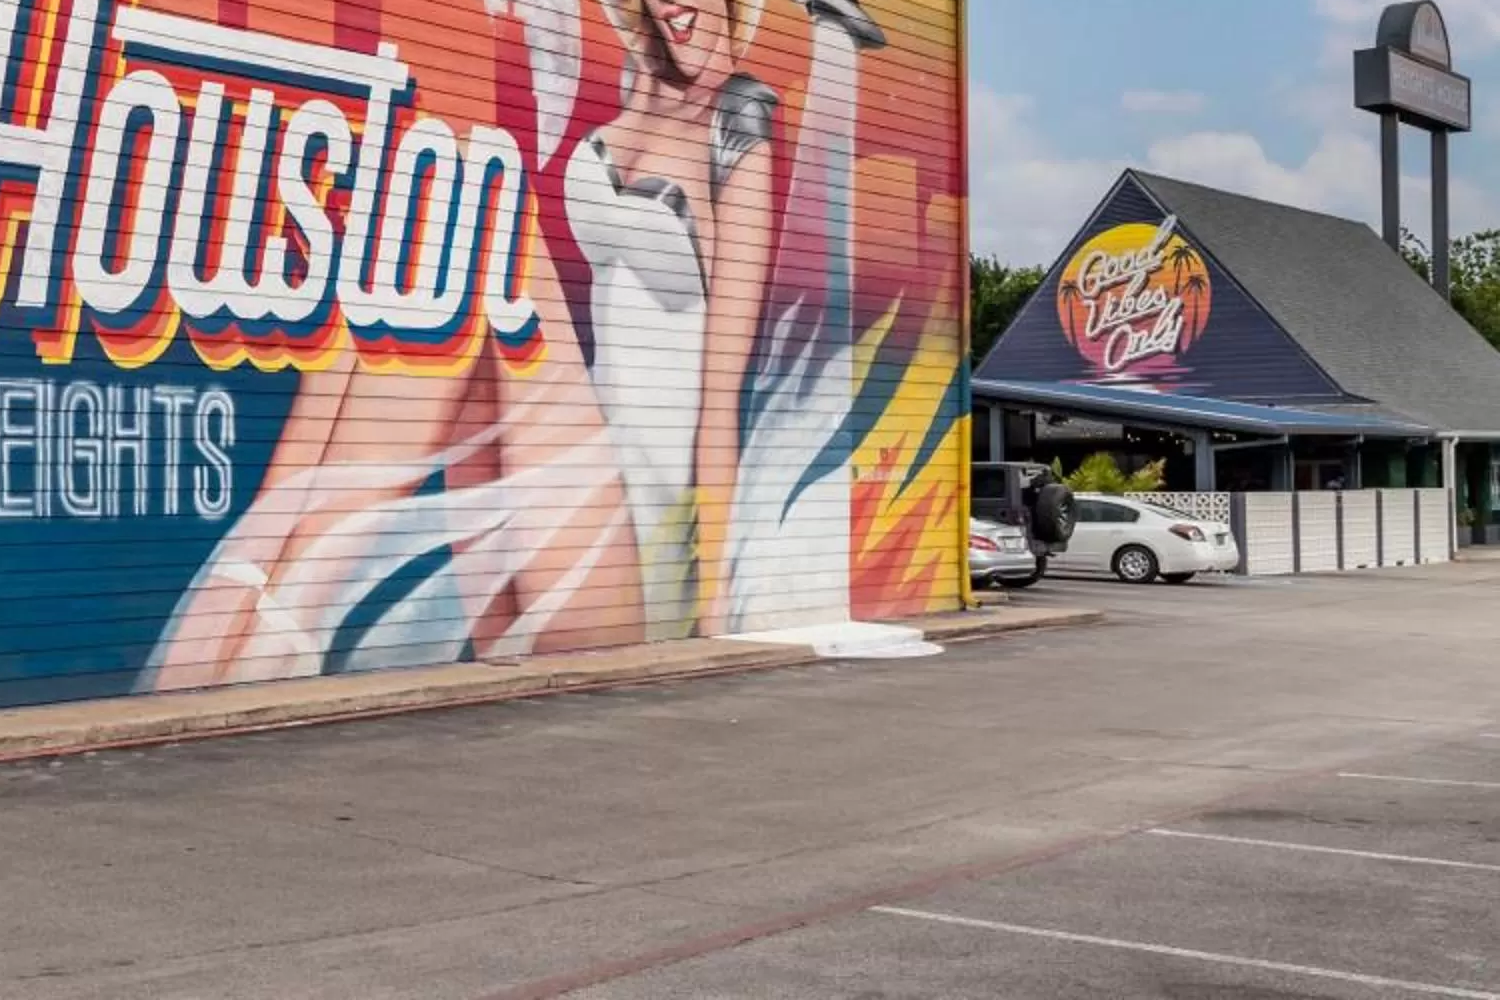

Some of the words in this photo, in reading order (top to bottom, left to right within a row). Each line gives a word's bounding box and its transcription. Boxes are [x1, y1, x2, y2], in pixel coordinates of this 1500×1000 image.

[1078, 214, 1177, 299] Good
[1082, 271, 1167, 340] Vibes
[1104, 298, 1184, 372] Only
